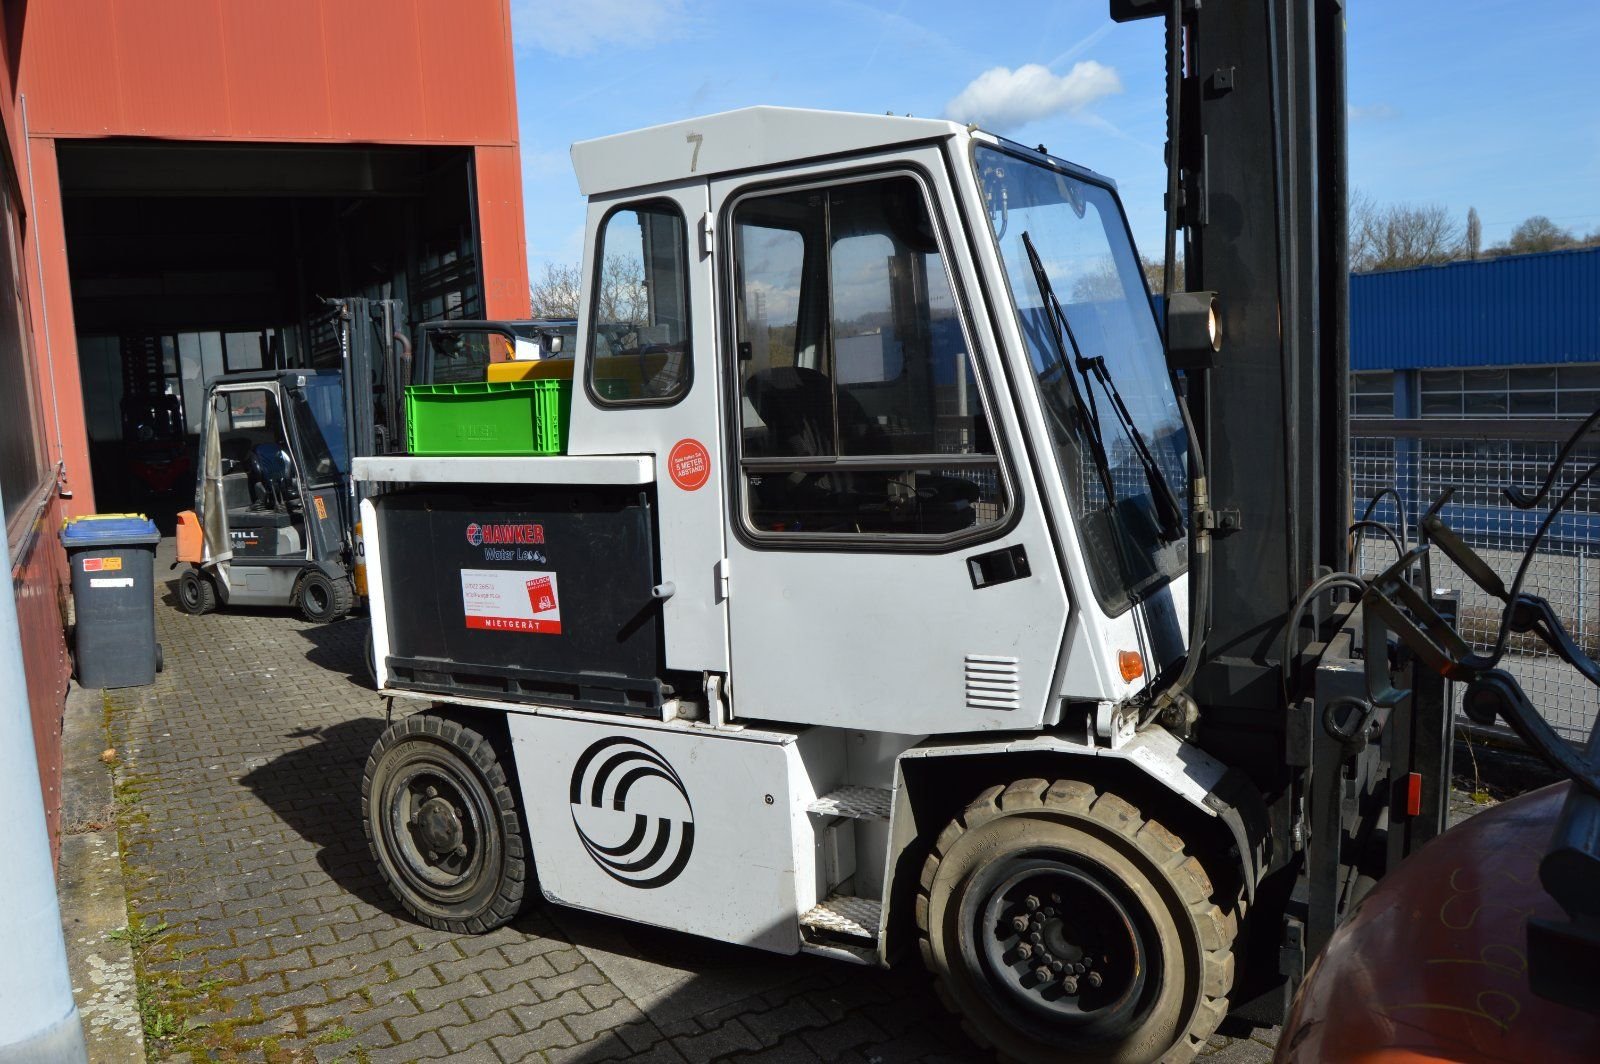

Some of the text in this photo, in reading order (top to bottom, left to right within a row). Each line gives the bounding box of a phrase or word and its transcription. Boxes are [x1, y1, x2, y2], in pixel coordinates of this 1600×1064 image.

[686, 134, 703, 172] 7
[681, 458, 703, 469] METER
[229, 531, 259, 539] TILL
[482, 524, 545, 544] HAWKER
[484, 547, 515, 561] Water
[485, 619, 540, 630] MIETGERÄT
